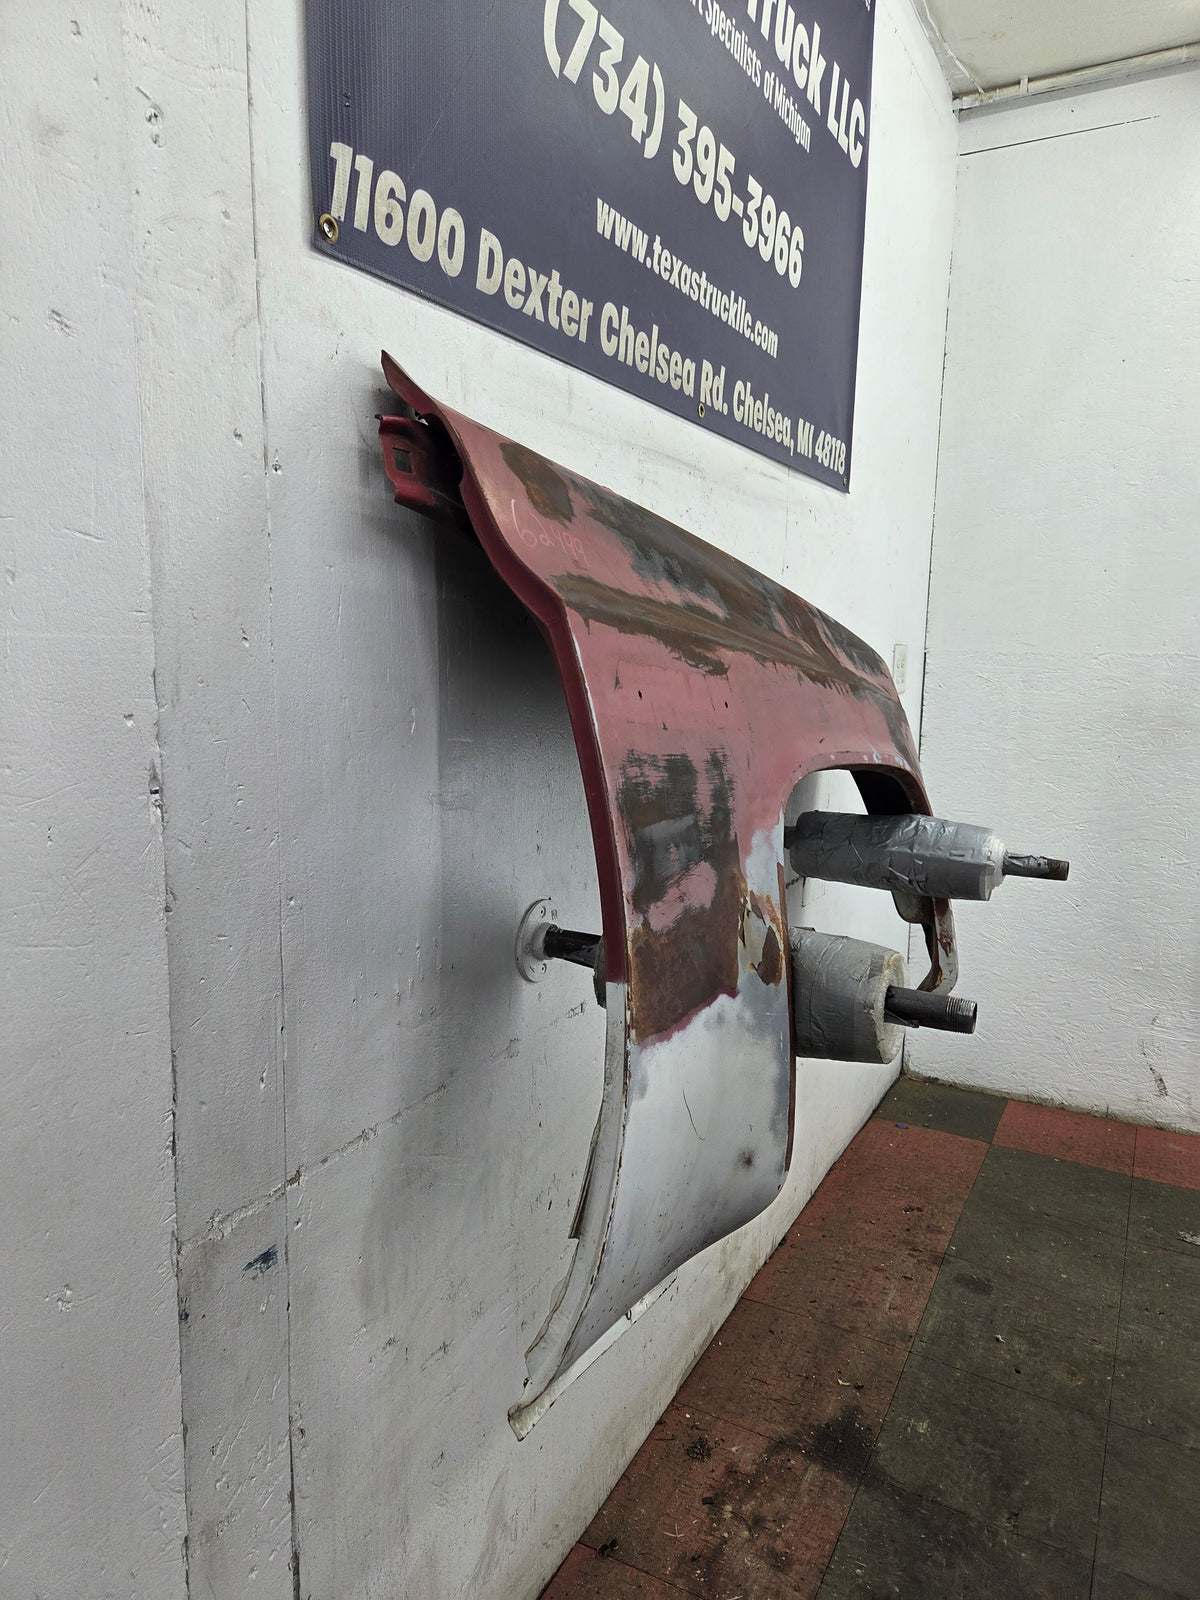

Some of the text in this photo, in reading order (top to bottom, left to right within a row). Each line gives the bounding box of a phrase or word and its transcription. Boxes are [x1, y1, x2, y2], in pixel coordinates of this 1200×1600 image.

[544, 0, 805, 289] (734) 395-3966
[705, 0, 811, 153] Specialists of Michigan
[747, 0, 866, 168] ruck LLC
[329, 141, 847, 476] 11600 Dexter Chelsea Rd. Chelsea, MI 48118
[596, 196, 779, 359] www.texastruckllc.com
